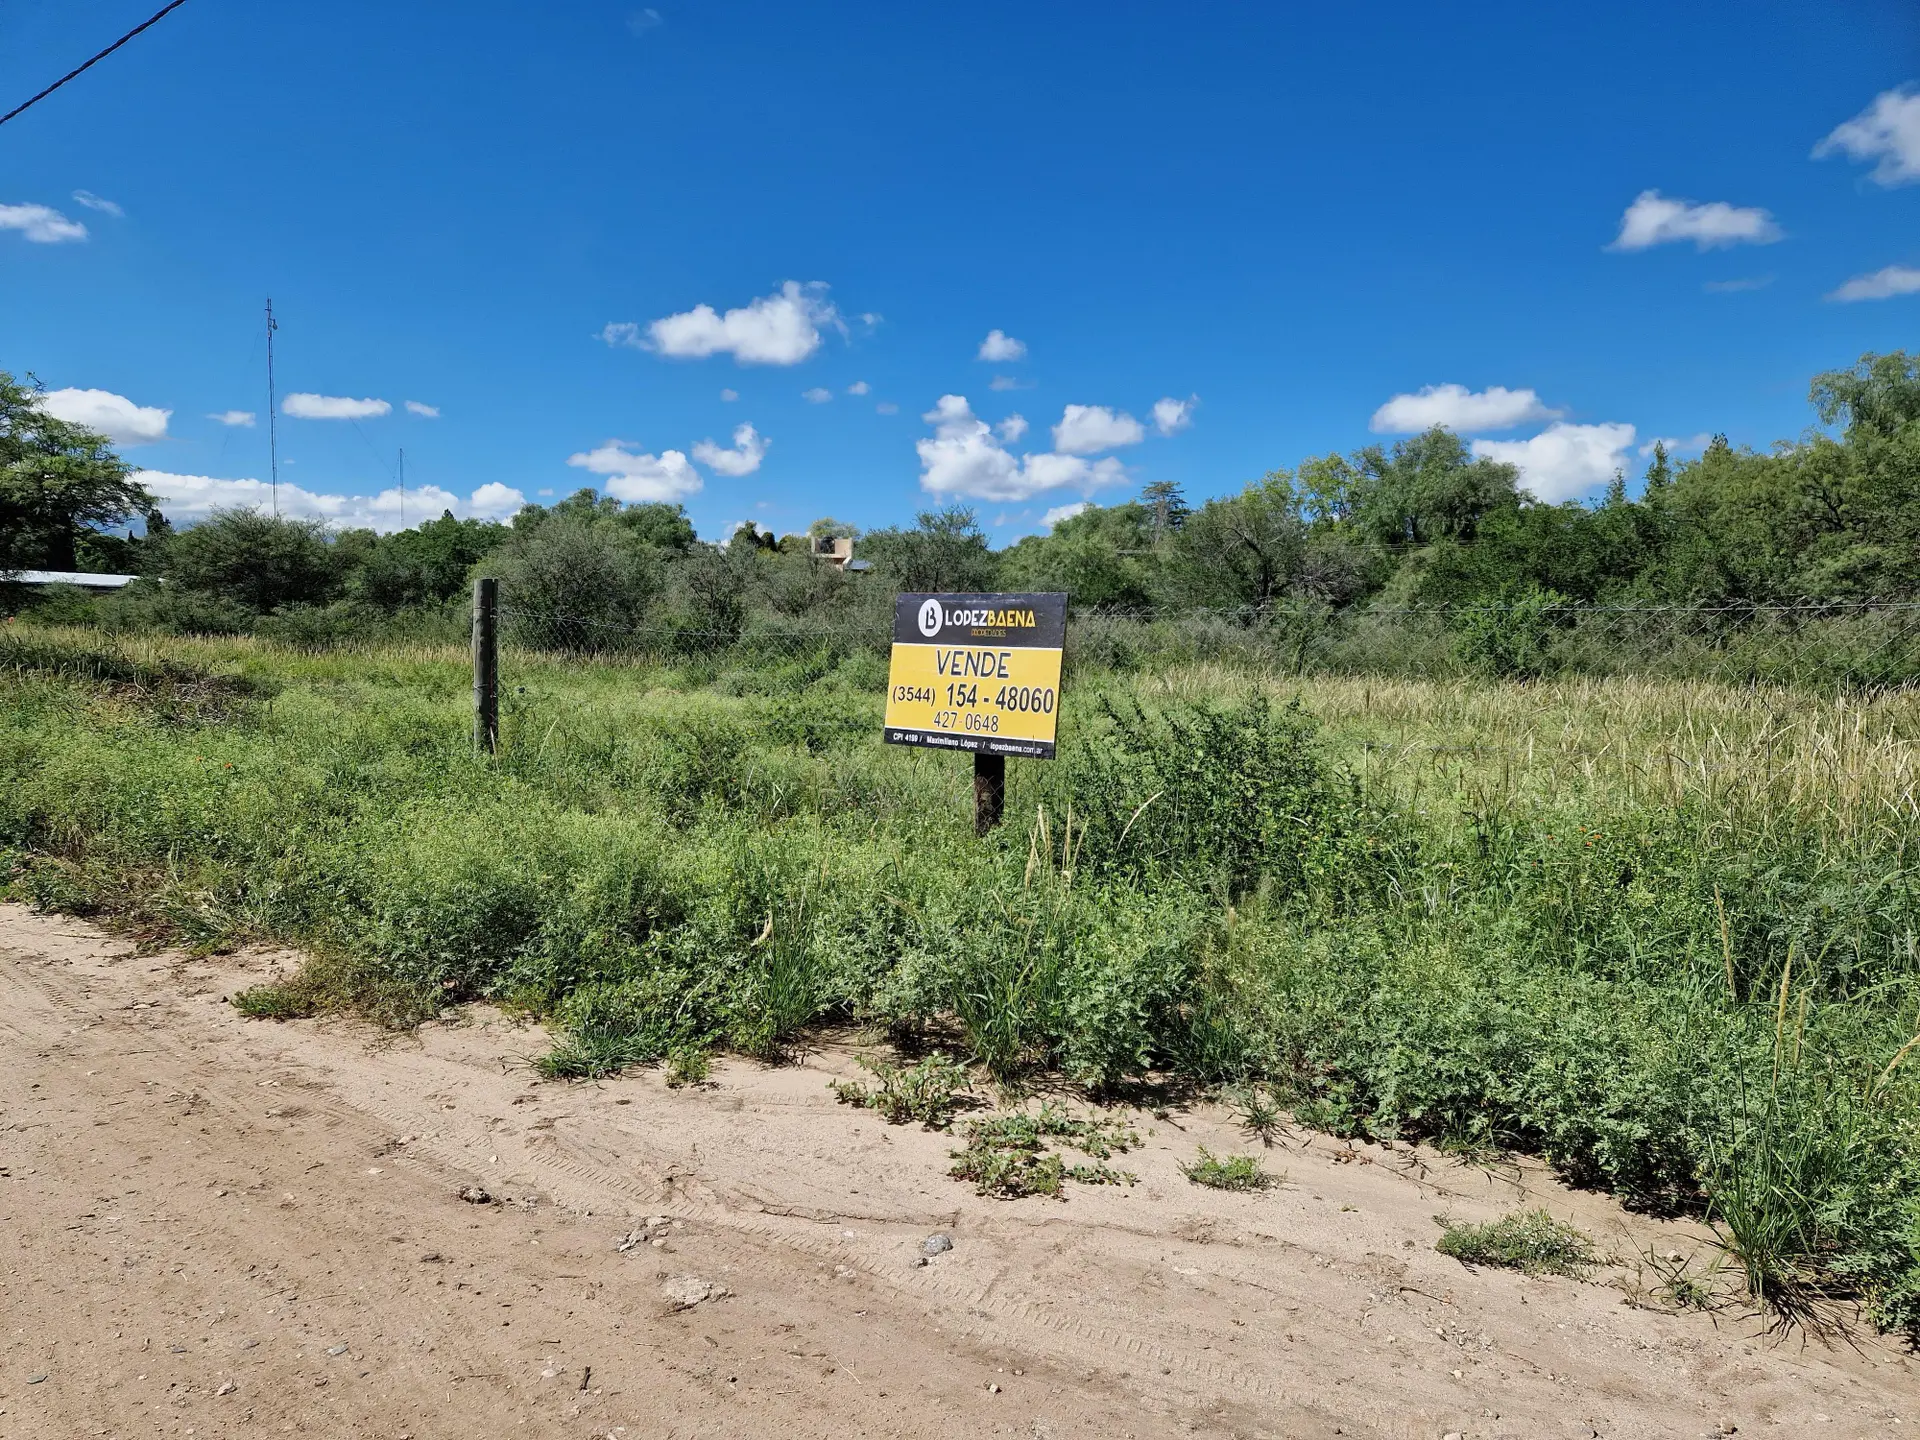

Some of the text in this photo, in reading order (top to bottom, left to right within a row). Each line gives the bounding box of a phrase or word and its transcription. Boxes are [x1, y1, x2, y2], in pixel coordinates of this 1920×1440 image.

[936, 650, 1012, 679] VENDE
[892, 685, 936, 707] (3544)
[893, 732, 904, 741] CPI
[926, 735, 959, 746] Maximiliano
[960, 739, 978, 749] López
